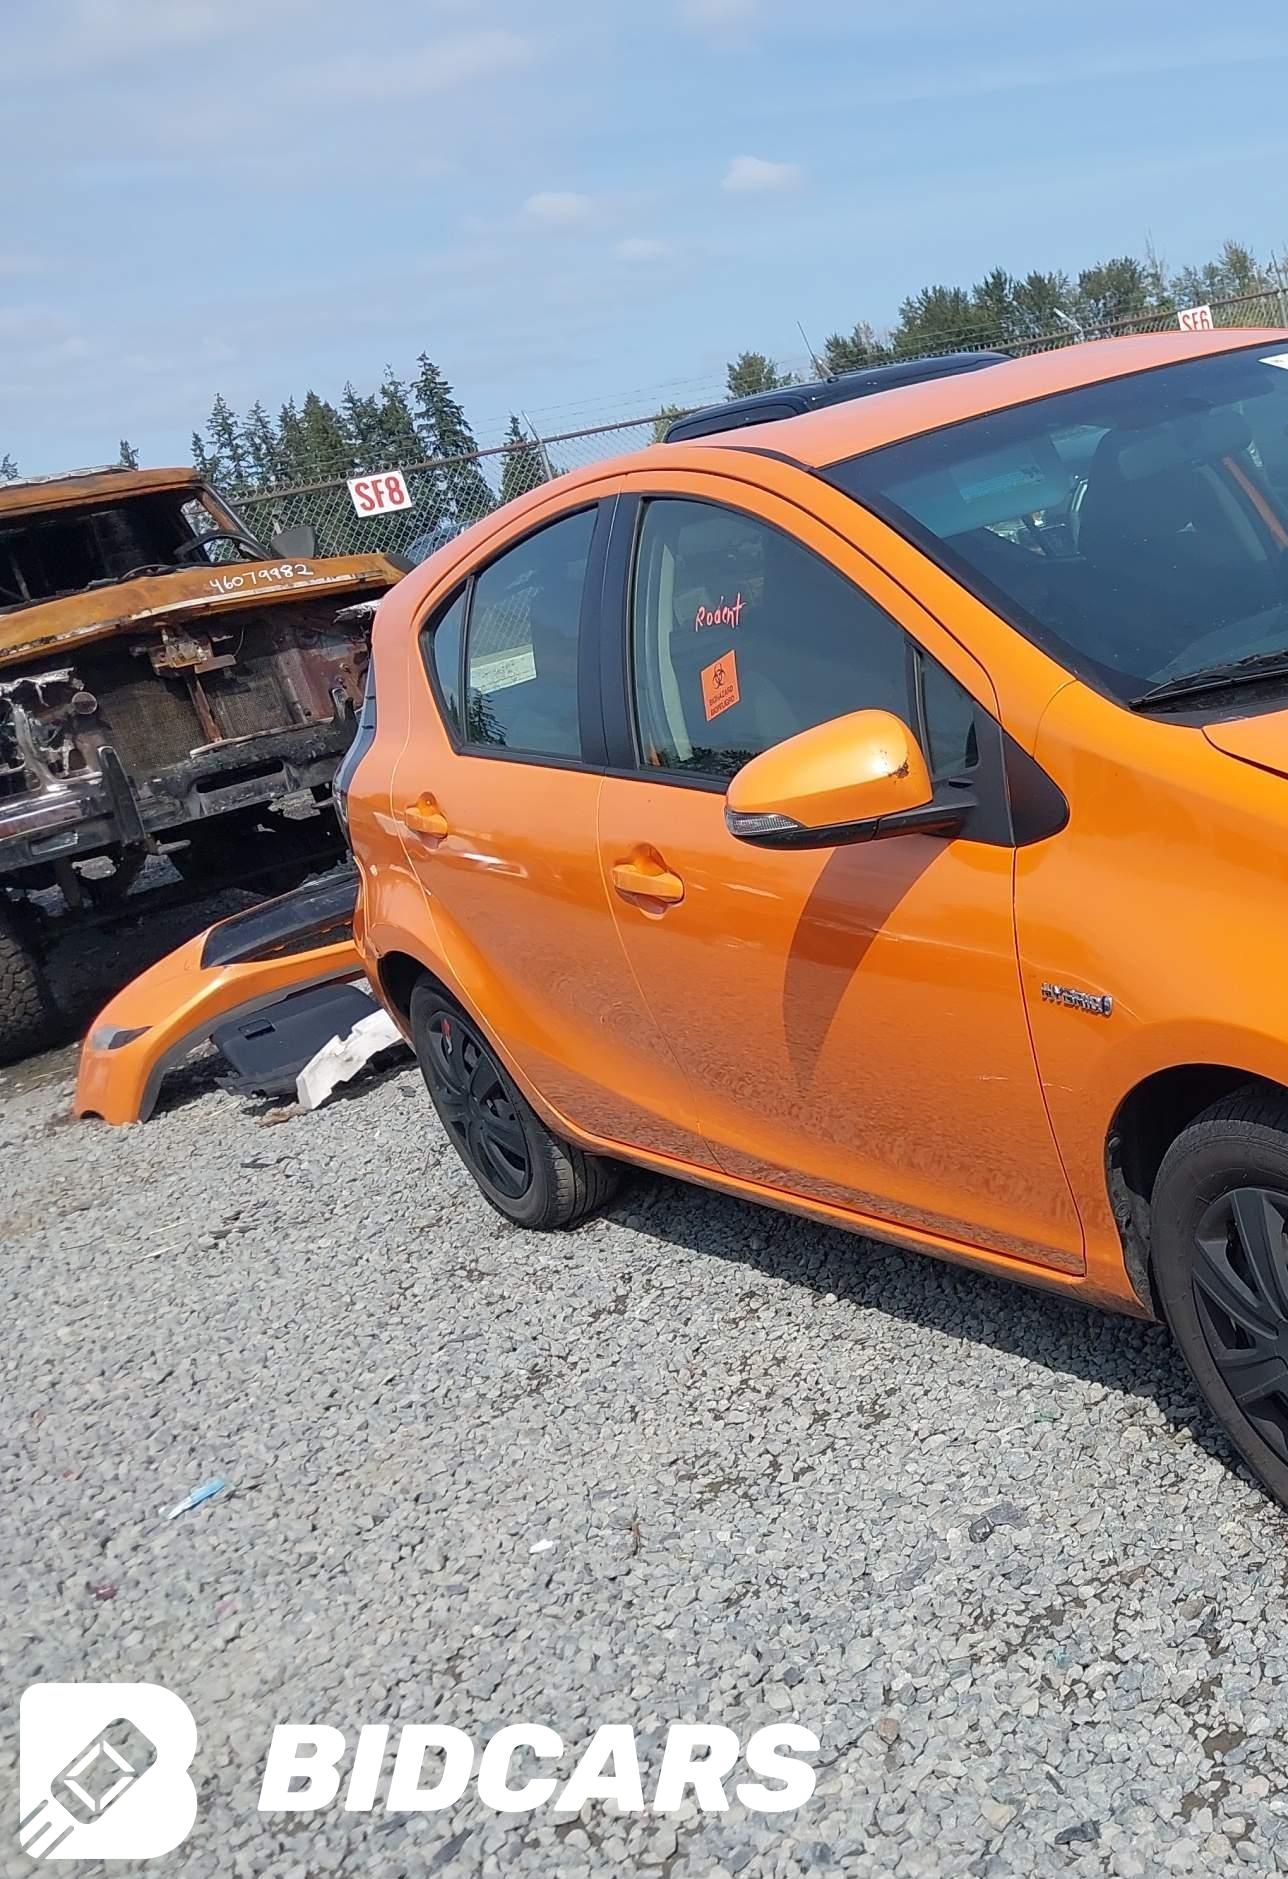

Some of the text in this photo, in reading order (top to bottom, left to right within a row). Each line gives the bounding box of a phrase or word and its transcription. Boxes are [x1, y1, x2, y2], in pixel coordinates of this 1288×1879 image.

[354, 476, 405, 511] SF8
[209, 564, 314, 593] 46079982
[695, 592, 746, 632] Rodent
